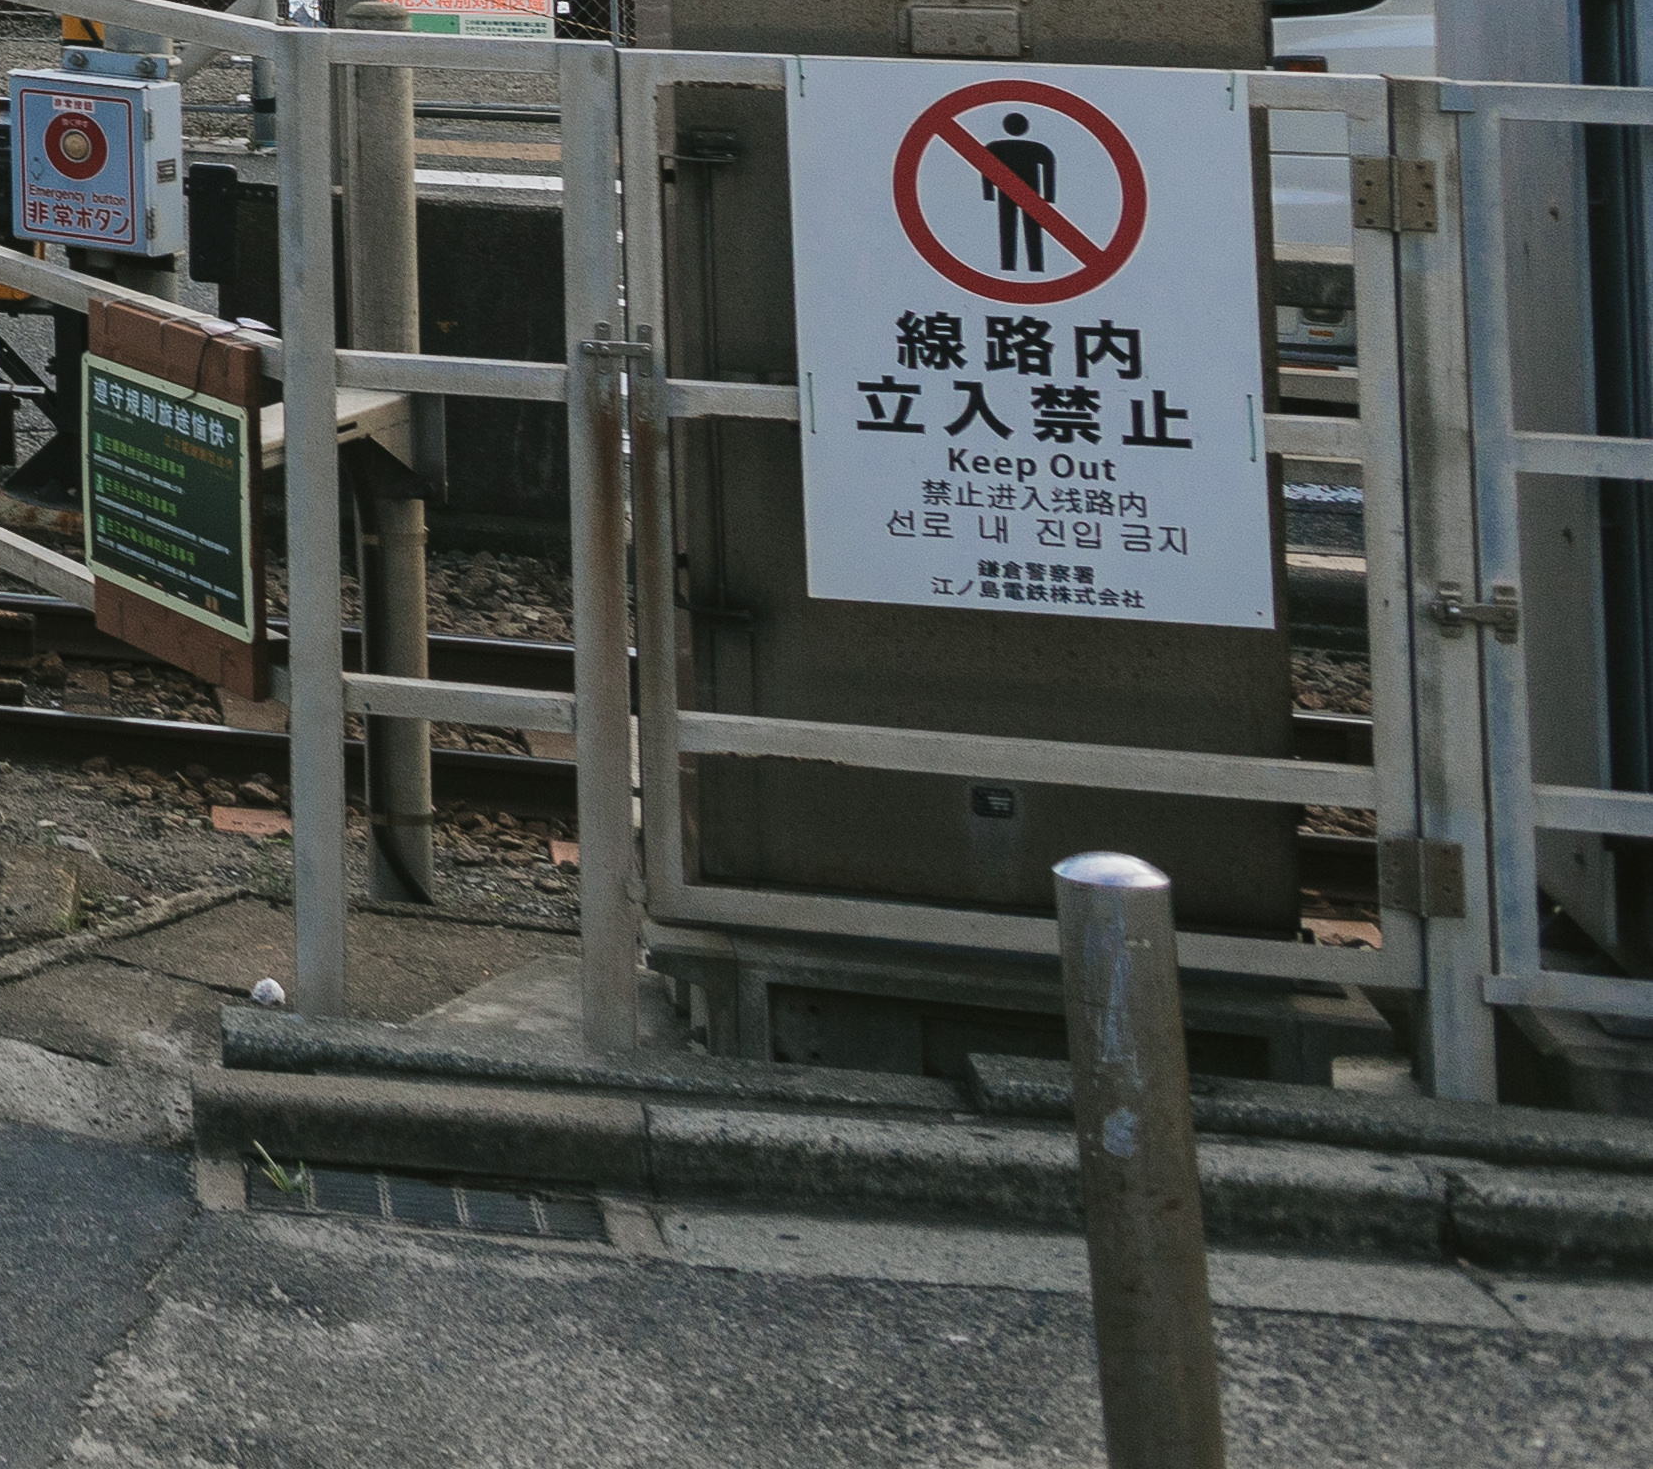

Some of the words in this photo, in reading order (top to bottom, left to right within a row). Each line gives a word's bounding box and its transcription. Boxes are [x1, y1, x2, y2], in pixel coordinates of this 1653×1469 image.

[29, 183, 86, 204] Emergency
[92, 192, 127, 207] button
[27, 200, 130, 235] 非常ボタン
[895, 309, 1144, 380] 線路内
[856, 375, 1193, 449] 立入禁止
[948, 447, 1037, 482] Keep
[1049, 454, 1117, 482] Out
[921, 479, 1148, 518] 禁止进入线路内
[886, 509, 954, 539] 선로
[978, 514, 1009, 544] 내
[1036, 518, 1102, 549] 진입
[1120, 524, 1188, 555] 금지
[978, 559, 1094, 584] 鎌倉警察署
[931, 576, 1145, 609] 江ノ島電鉄株式会社
